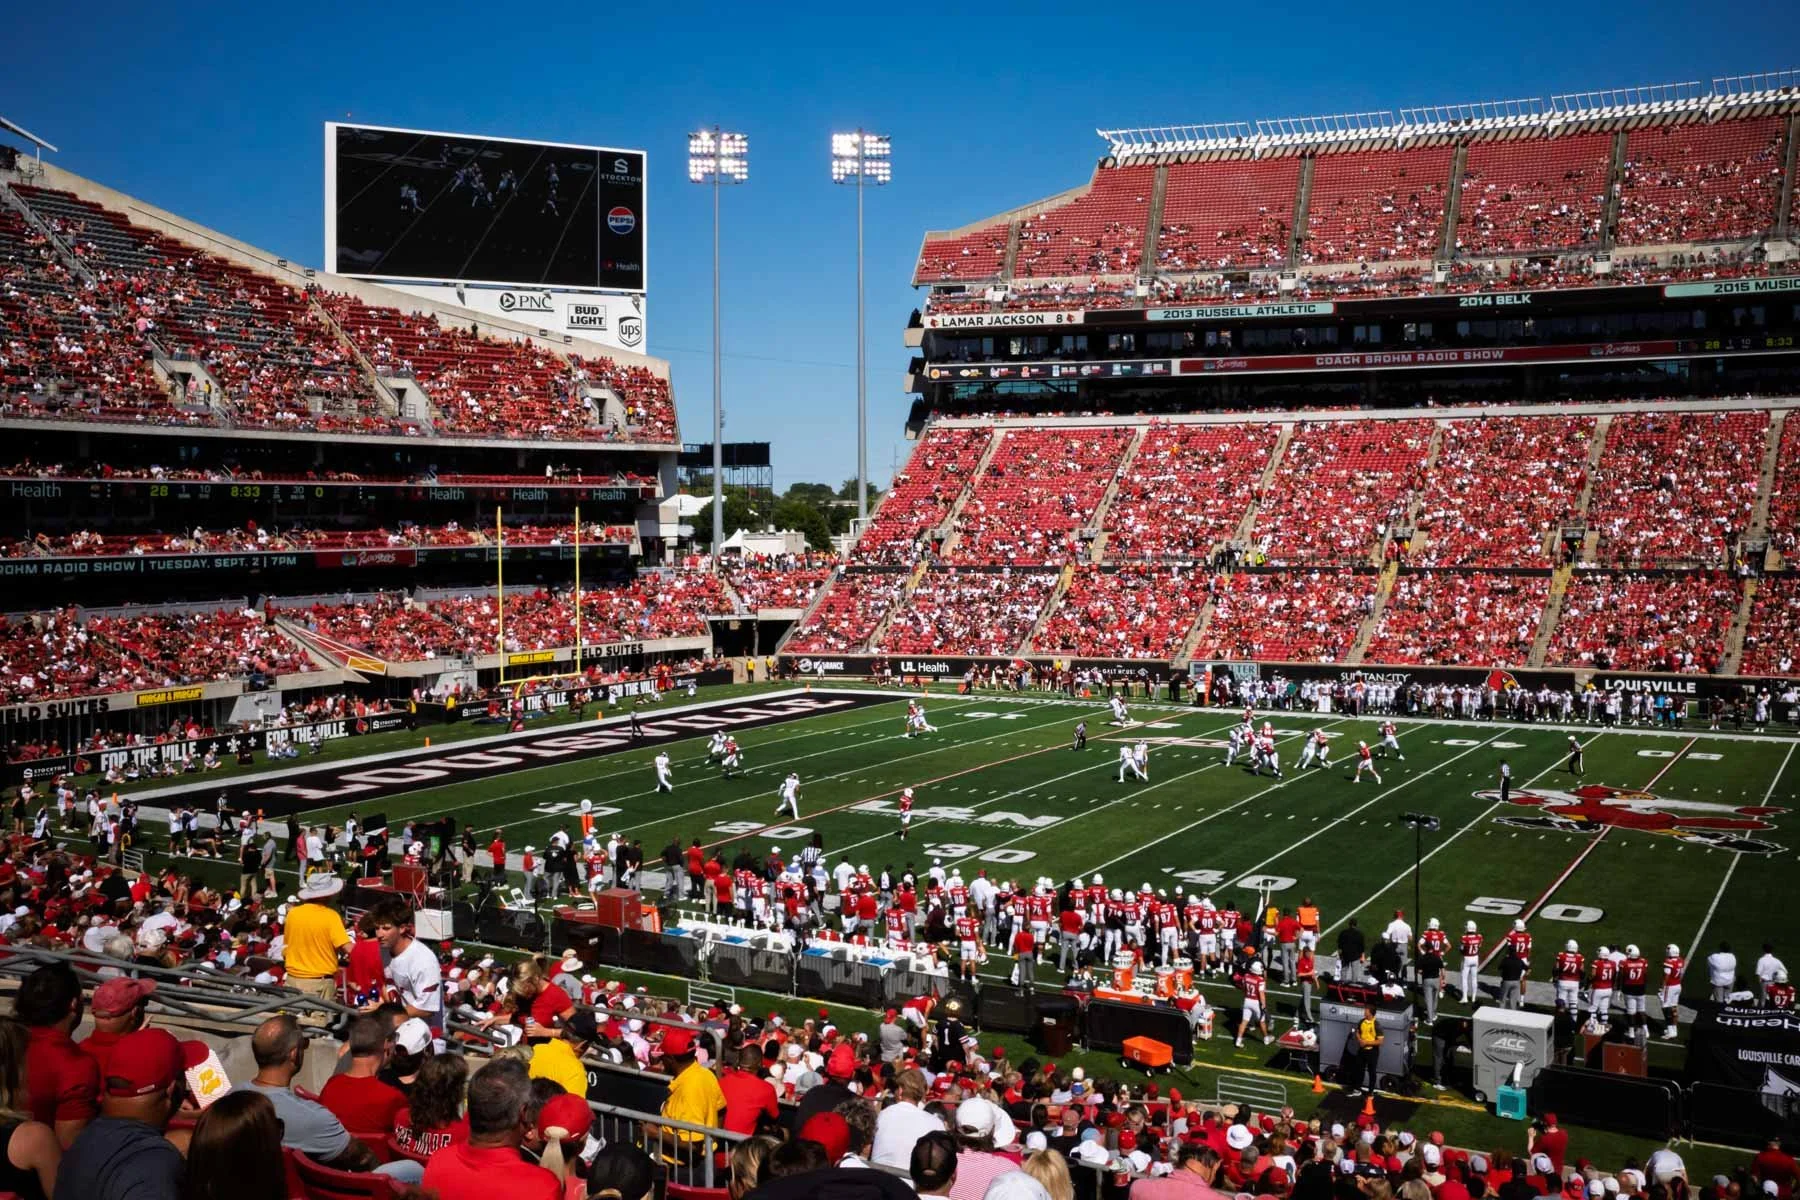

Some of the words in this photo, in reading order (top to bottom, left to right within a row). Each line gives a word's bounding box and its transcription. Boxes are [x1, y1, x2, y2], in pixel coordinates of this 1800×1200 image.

[600, 174, 641, 182] STOCKTON
[608, 215, 634, 225] PEPSI
[616, 262, 640, 272] Health
[1714, 282, 1750, 293] 2015
[519, 293, 552, 309] PNC
[1459, 296, 1492, 307] 2014
[1496, 294, 1531, 305] BELK
[575, 306, 599, 316] BUD
[1163, 309, 1192, 319] 2013
[1196, 306, 1253, 317] RUSSELL
[1256, 303, 1316, 316] ATHLETIC
[570, 315, 604, 326] LIGHT
[941, 316, 984, 328] LAMAR
[987, 313, 1045, 327] JACKSON
[1055, 313, 1063, 324] 8
[622, 322, 641, 338] ups
[1315, 356, 1360, 365] COACH
[1365, 354, 1412, 364] BROHM
[1417, 352, 1458, 362] RADIO
[1463, 351, 1504, 361] SHOW
[12, 481, 62, 497] Health
[150, 485, 169, 497] 28
[231, 485, 260, 498] 8:33
[315, 486, 324, 498] 0
[429, 488, 465, 500] Health
[513, 488, 549, 501] Health
[593, 488, 626, 501] Health
[43, 562, 88, 573] RADIO
[93, 561, 136, 572] SHOW
[251, 557, 259, 567] 2
[271, 556, 297, 566] 7PM
[571, 646, 602, 660] FELD
[606, 644, 643, 656] SUITES
[900, 661, 916, 672] UL
[918, 662, 950, 672] Health
[1363, 673, 1385, 682] TAN
[1385, 673, 1412, 682] CITY
[1605, 680, 1697, 693] LOUISVILLE
[48, 699, 109, 719] SUITES
[248, 697, 855, 800] LOUISVILLE
[131, 746, 159, 767] THE
[923, 843, 1037, 863] 30
[1172, 869, 1297, 891] 40
[1465, 896, 1604, 923] 50
[1630, 968, 1642, 980] 67
[1724, 1006, 1796, 1015] Medicine
[1716, 1015, 1800, 1032] Health
[943, 1028, 950, 1046] 1
[1491, 1036, 1528, 1050] ACC
[1738, 1049, 1783, 1064] LOUISVILLE
